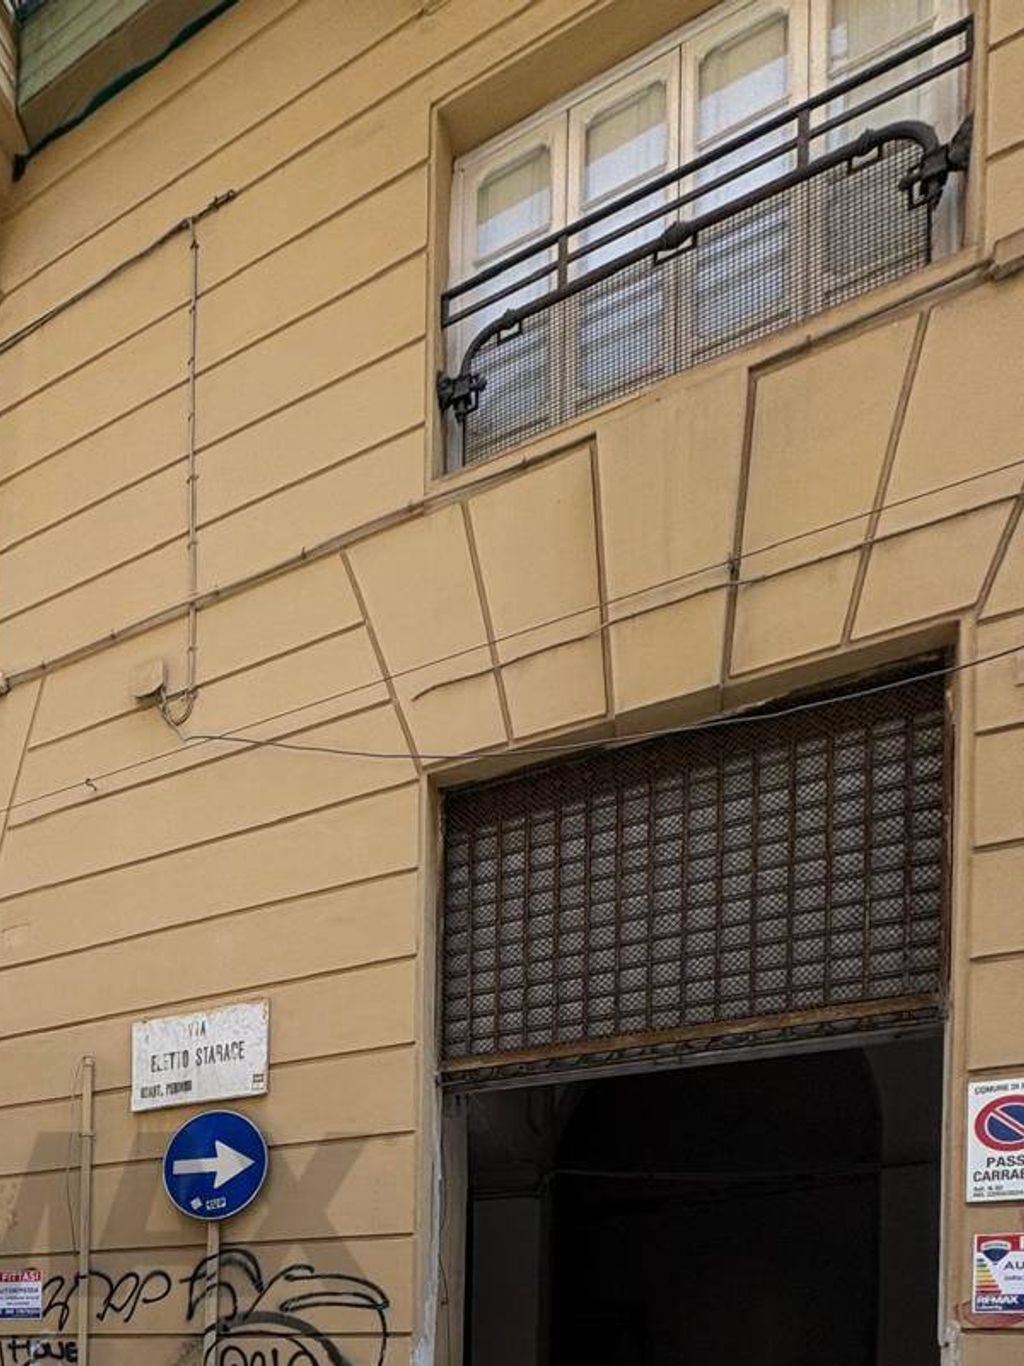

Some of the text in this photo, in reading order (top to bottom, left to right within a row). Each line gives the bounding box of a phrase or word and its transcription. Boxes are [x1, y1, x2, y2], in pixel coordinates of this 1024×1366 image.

[188, 1021, 206, 1037] VIA
[151, 1041, 245, 1073] ELETTO STARACE
